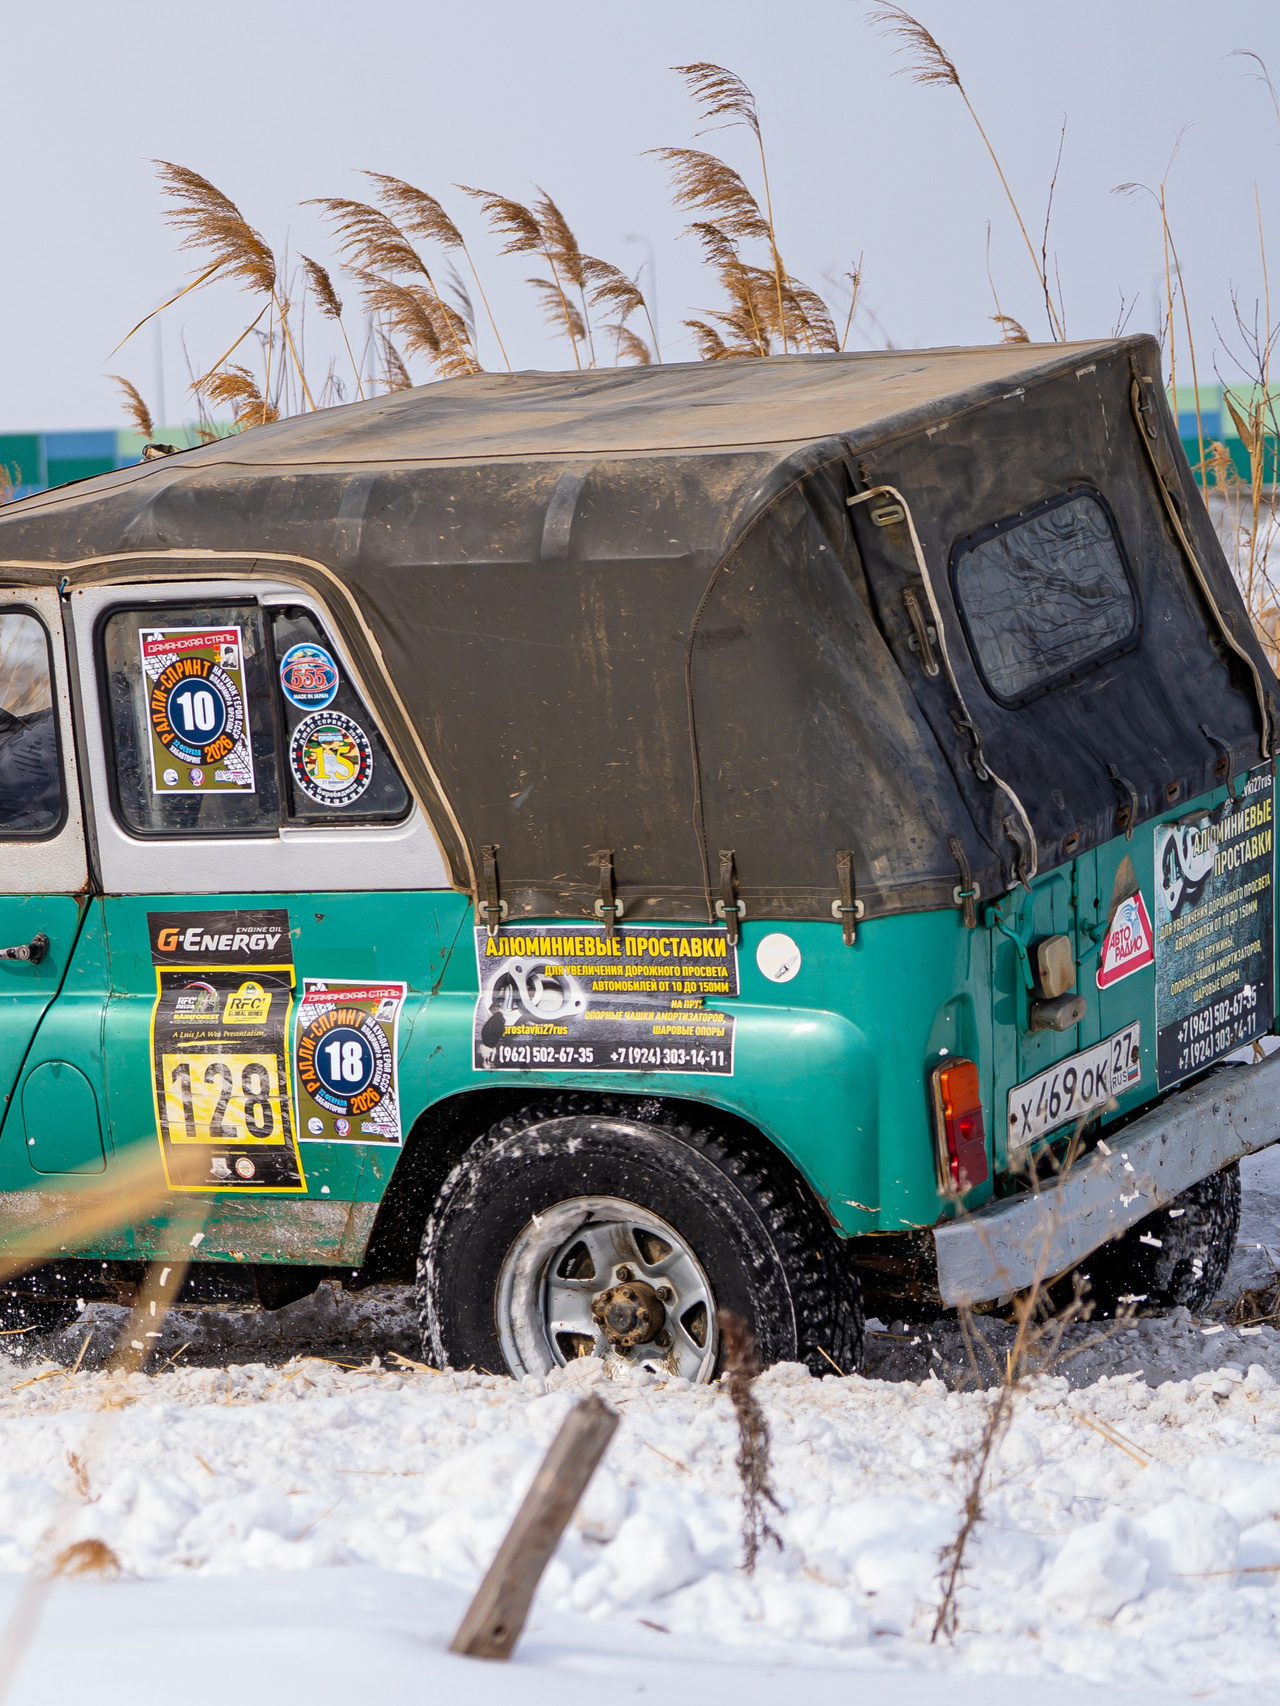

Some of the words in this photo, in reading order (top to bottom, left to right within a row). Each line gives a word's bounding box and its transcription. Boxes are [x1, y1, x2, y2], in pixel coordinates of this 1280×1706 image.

[147, 637, 203, 653] ДАМАНСКАЯ
[205, 634, 235, 645] СТАЛЬ
[212, 665, 223, 677] НА
[291, 667, 327, 688] 555
[221, 671, 240, 697] КУБОК
[151, 659, 211, 744] РАЛЛИ-СПРИНТ
[176, 690, 216, 731] 10
[232, 696, 244, 720] ГЕРОЯ
[232, 721, 243, 740] СССР
[204, 734, 233, 763] 2026
[312, 745, 355, 780] 15
[1242, 774, 1272, 797] vki27rus
[1193, 798, 1272, 858] АЛЮМИНИЕВЫЕ
[1214, 829, 1272, 877] ПРОСТАВКИ
[1159, 923, 1173, 942] ДЛЯ
[1173, 905, 1208, 933] УВЕЛИЧЕНИЯ
[1208, 887, 1244, 916] ДОРОЖНОГО
[1244, 873, 1271, 897] ПРОСВЕТА
[486, 936, 622, 957] АЛЮМИНИЕВЫЕ
[625, 936, 727, 958] ПРОСТАВКИ
[1109, 925, 1131, 950] АВТО
[1115, 935, 1143, 962] РАДИО
[1196, 950, 1205, 963] НА
[544, 965, 564, 978] ДЛЯ
[565, 965, 624, 977] УВЕЛИЧЕНИЯ
[625, 965, 681, 978] ДОРОЖНОГО
[682, 966, 729, 977] ПРОСВЕТА
[1170, 973, 1196, 996] ОПОРНЫЕ
[1195, 962, 1216, 981] ЧАШКИ
[308, 990, 367, 1002] ДАМАНСКАЯ
[368, 988, 400, 999] СТАЛЬ
[592, 979, 657, 992] АВТОМОБИЛЕЙ
[659, 981, 670, 992] ОТ
[672, 981, 682, 992] 10
[683, 981, 697, 993] ДО
[699, 982, 729, 993] 150ММ
[1193, 978, 1220, 1003] ШАРОВЫЕ
[1220, 968, 1240, 988] ОПОРЫ
[584, 1010, 623, 1021] ОПОРНЫЕ
[624, 1011, 655, 1021] ЧАШКИ
[656, 1012, 727, 1024] АМОРТИЗАТОРОВ,
[671, 1000, 683, 1009] НА
[1178, 1021, 1188, 1043] +7
[1189, 1006, 1213, 1040] (962)
[1214, 985, 1257, 1026] 502-67-35
[365, 1016, 375, 1029] НА
[652, 1025, 694, 1036] ШАРОВЫЕ
[695, 1026, 725, 1036] ОПОРЫ
[373, 1024, 389, 1050] КУБОК
[1179, 1048, 1189, 1070] +7
[1190, 1033, 1214, 1067] (924)
[1215, 1012, 1257, 1053] 303-14-11
[298, 1008, 366, 1092] РАЛЛИ-СПРИНТ
[324, 1041, 364, 1082] 18
[499, 1045, 531, 1064] (962)
[533, 1047, 594, 1063] 502-67-35
[610, 1048, 627, 1063] +7
[628, 1046, 661, 1065] (924)
[663, 1048, 725, 1066] 303-14-11
[1113, 1031, 1132, 1075] 27
[379, 1073, 391, 1093] СССР
[1112, 1070, 1128, 1089] RUS
[170, 1062, 275, 1139] 128
[350, 1087, 380, 1114] 2026
